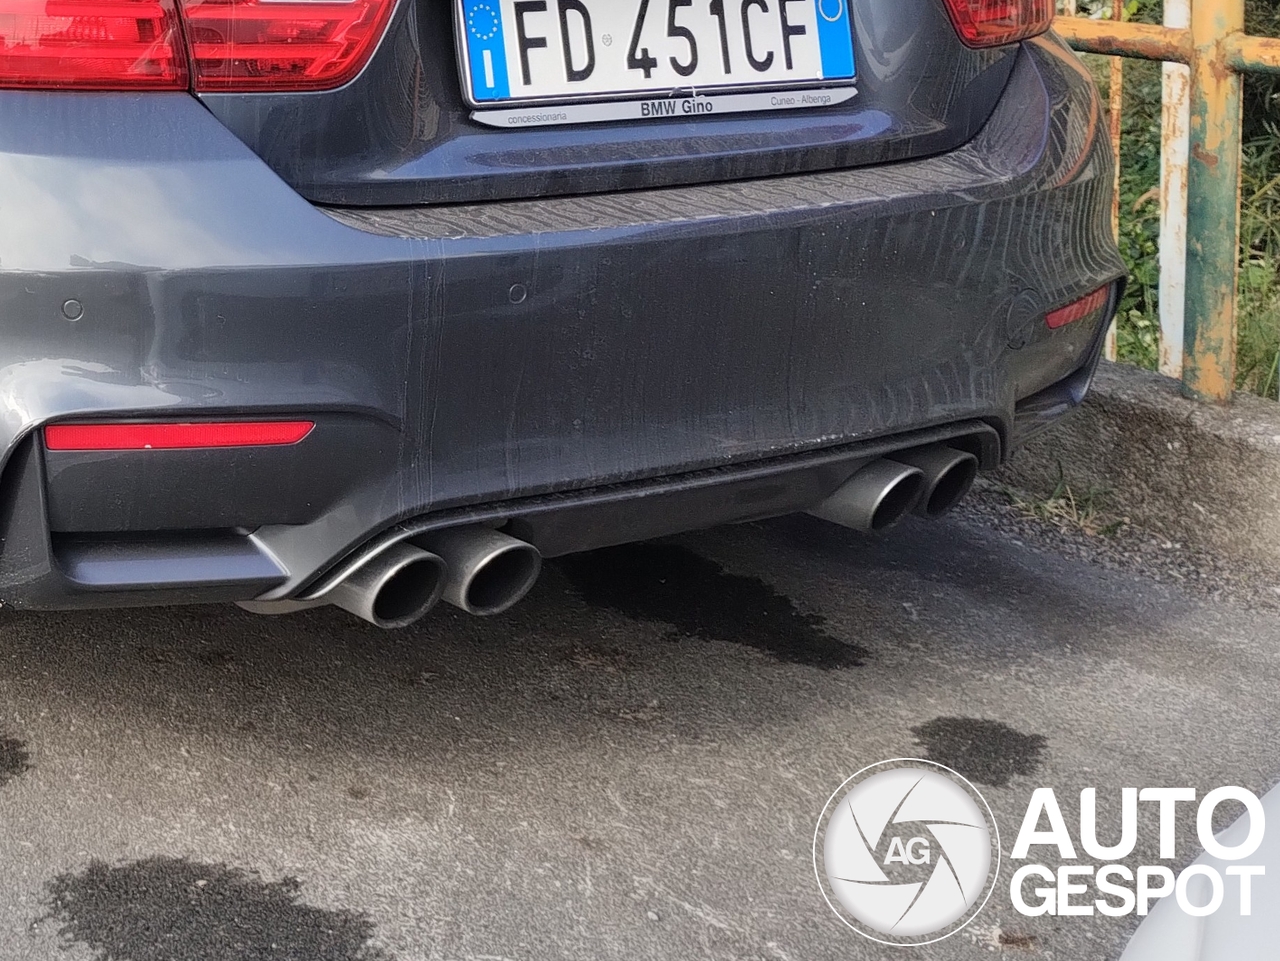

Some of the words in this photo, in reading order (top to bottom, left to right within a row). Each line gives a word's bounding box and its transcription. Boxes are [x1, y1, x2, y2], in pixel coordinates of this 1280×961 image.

[640, 99, 677, 116] BMW
[681, 96, 714, 115] Gino
[770, 96, 795, 106] Cuneo
[801, 94, 831, 105] Albenga
[507, 111, 568, 124] concessionaria
